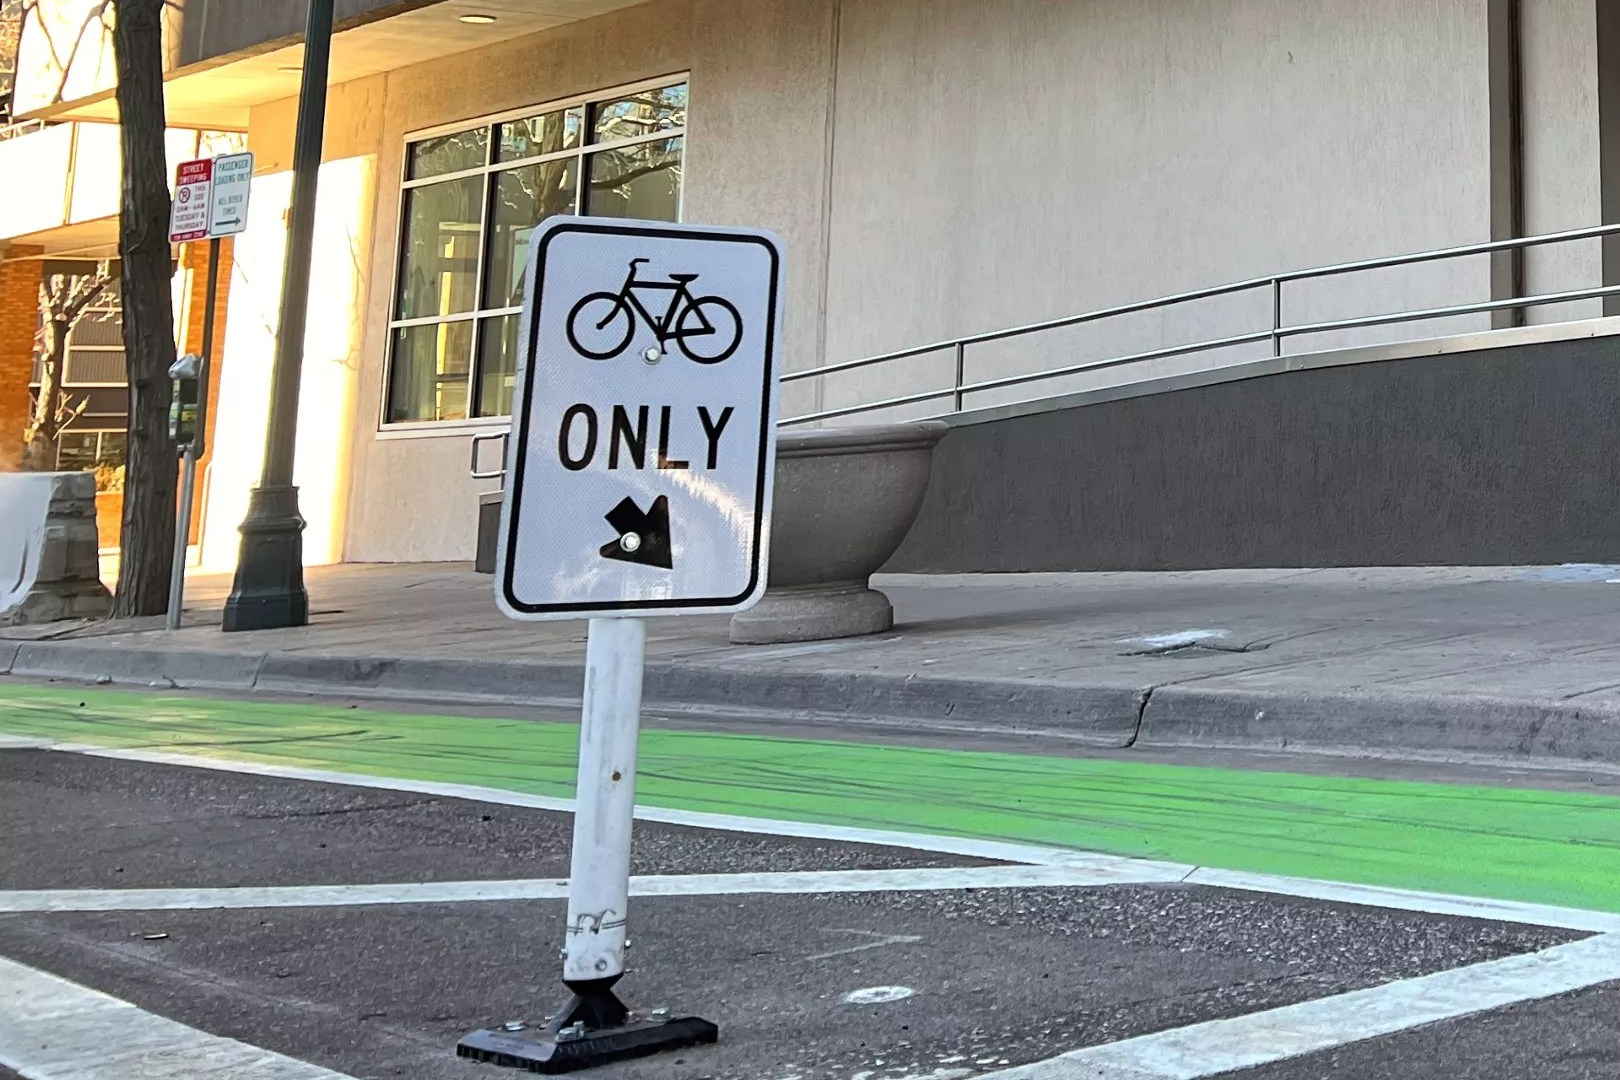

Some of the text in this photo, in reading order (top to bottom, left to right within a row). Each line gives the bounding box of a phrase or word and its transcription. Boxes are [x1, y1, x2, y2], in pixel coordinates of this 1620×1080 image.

[183, 163, 204, 175] STREET
[218, 159, 248, 172] PASSENGER
[179, 173, 207, 184] SWEEPING
[215, 172, 249, 184] LOADING ONLY
[175, 213, 199, 222] TUESDAY
[175, 221, 204, 230] THURSDAY
[558, 403, 735, 472] ONLY
